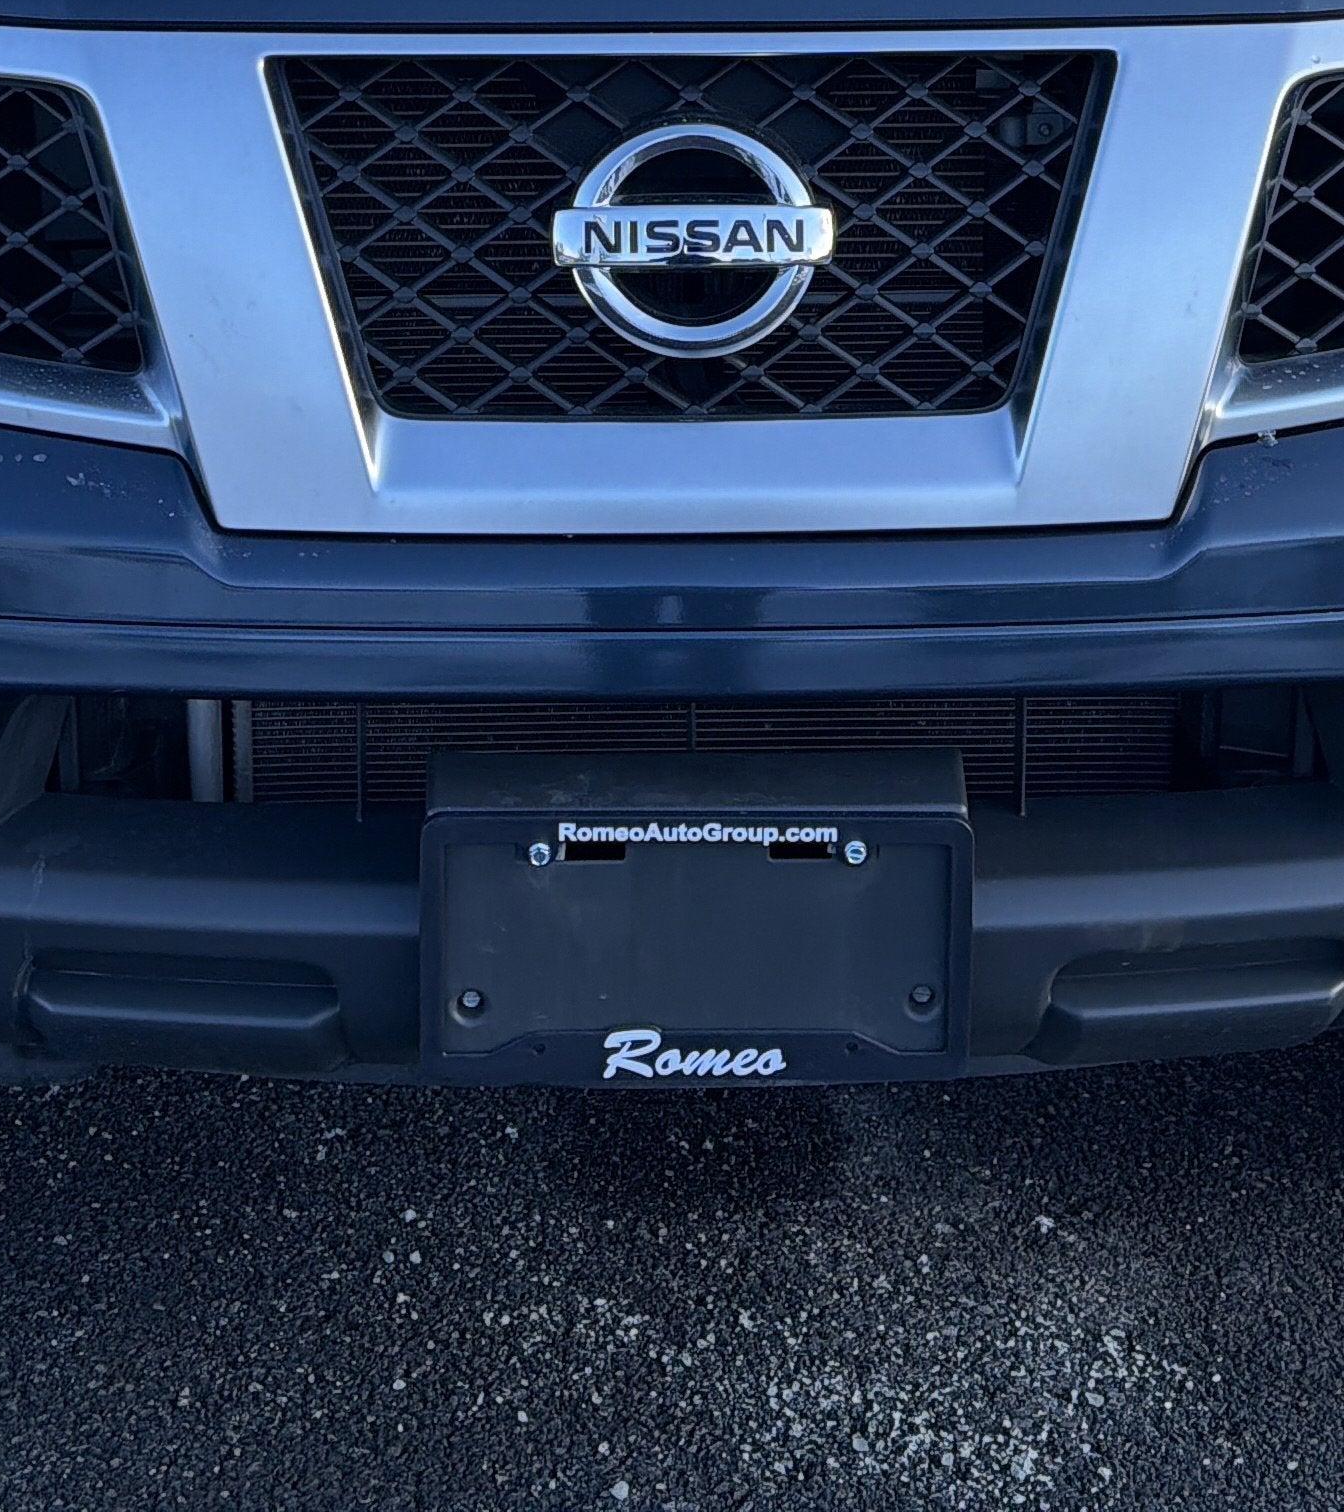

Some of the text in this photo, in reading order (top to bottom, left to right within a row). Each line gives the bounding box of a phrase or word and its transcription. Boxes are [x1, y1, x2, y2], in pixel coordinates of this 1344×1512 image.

[584, 219, 804, 253] NISSAN
[558, 822, 838, 846] RomeoAutoGroup.com
[603, 1029, 787, 1080] Romeo
